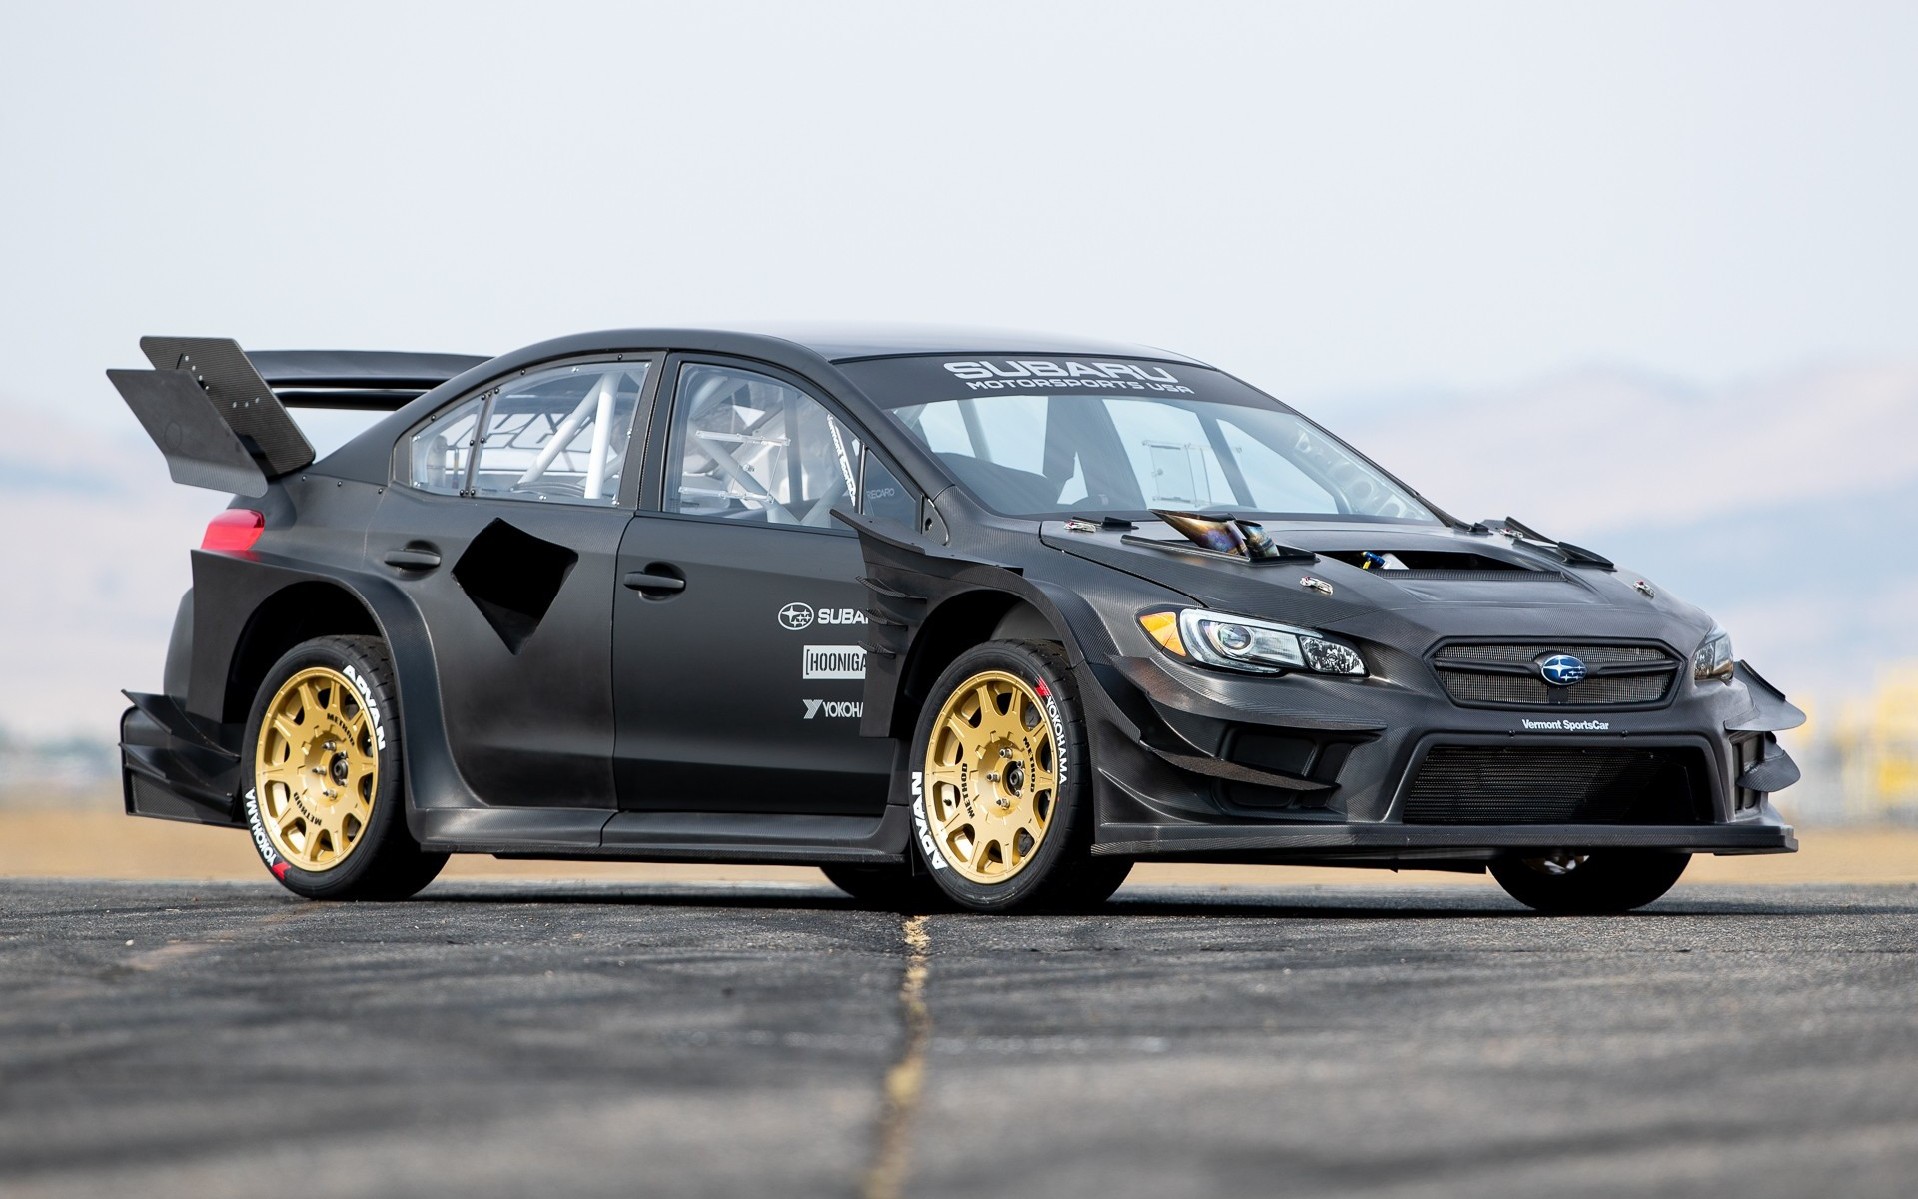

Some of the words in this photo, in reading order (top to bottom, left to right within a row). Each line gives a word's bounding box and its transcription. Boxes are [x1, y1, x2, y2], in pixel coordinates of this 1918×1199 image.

[943, 360, 1179, 384] SUBARU
[966, 378, 1145, 391] MOTORSPORTS
[1147, 382, 1196, 395] USA
[866, 487, 895, 499] RECARO
[817, 608, 869, 624] SUBA
[342, 664, 387, 751] ADVAN
[1521, 718, 1562, 730] Vermont
[1562, 719, 1610, 731] SportsCar
[327, 712, 356, 747] METHOD
[1046, 695, 1068, 785] YOKOHAMA
[961, 762, 975, 819] METHOD
[245, 786, 277, 868] YOKOHAMA
[911, 771, 949, 870] ADVAN
